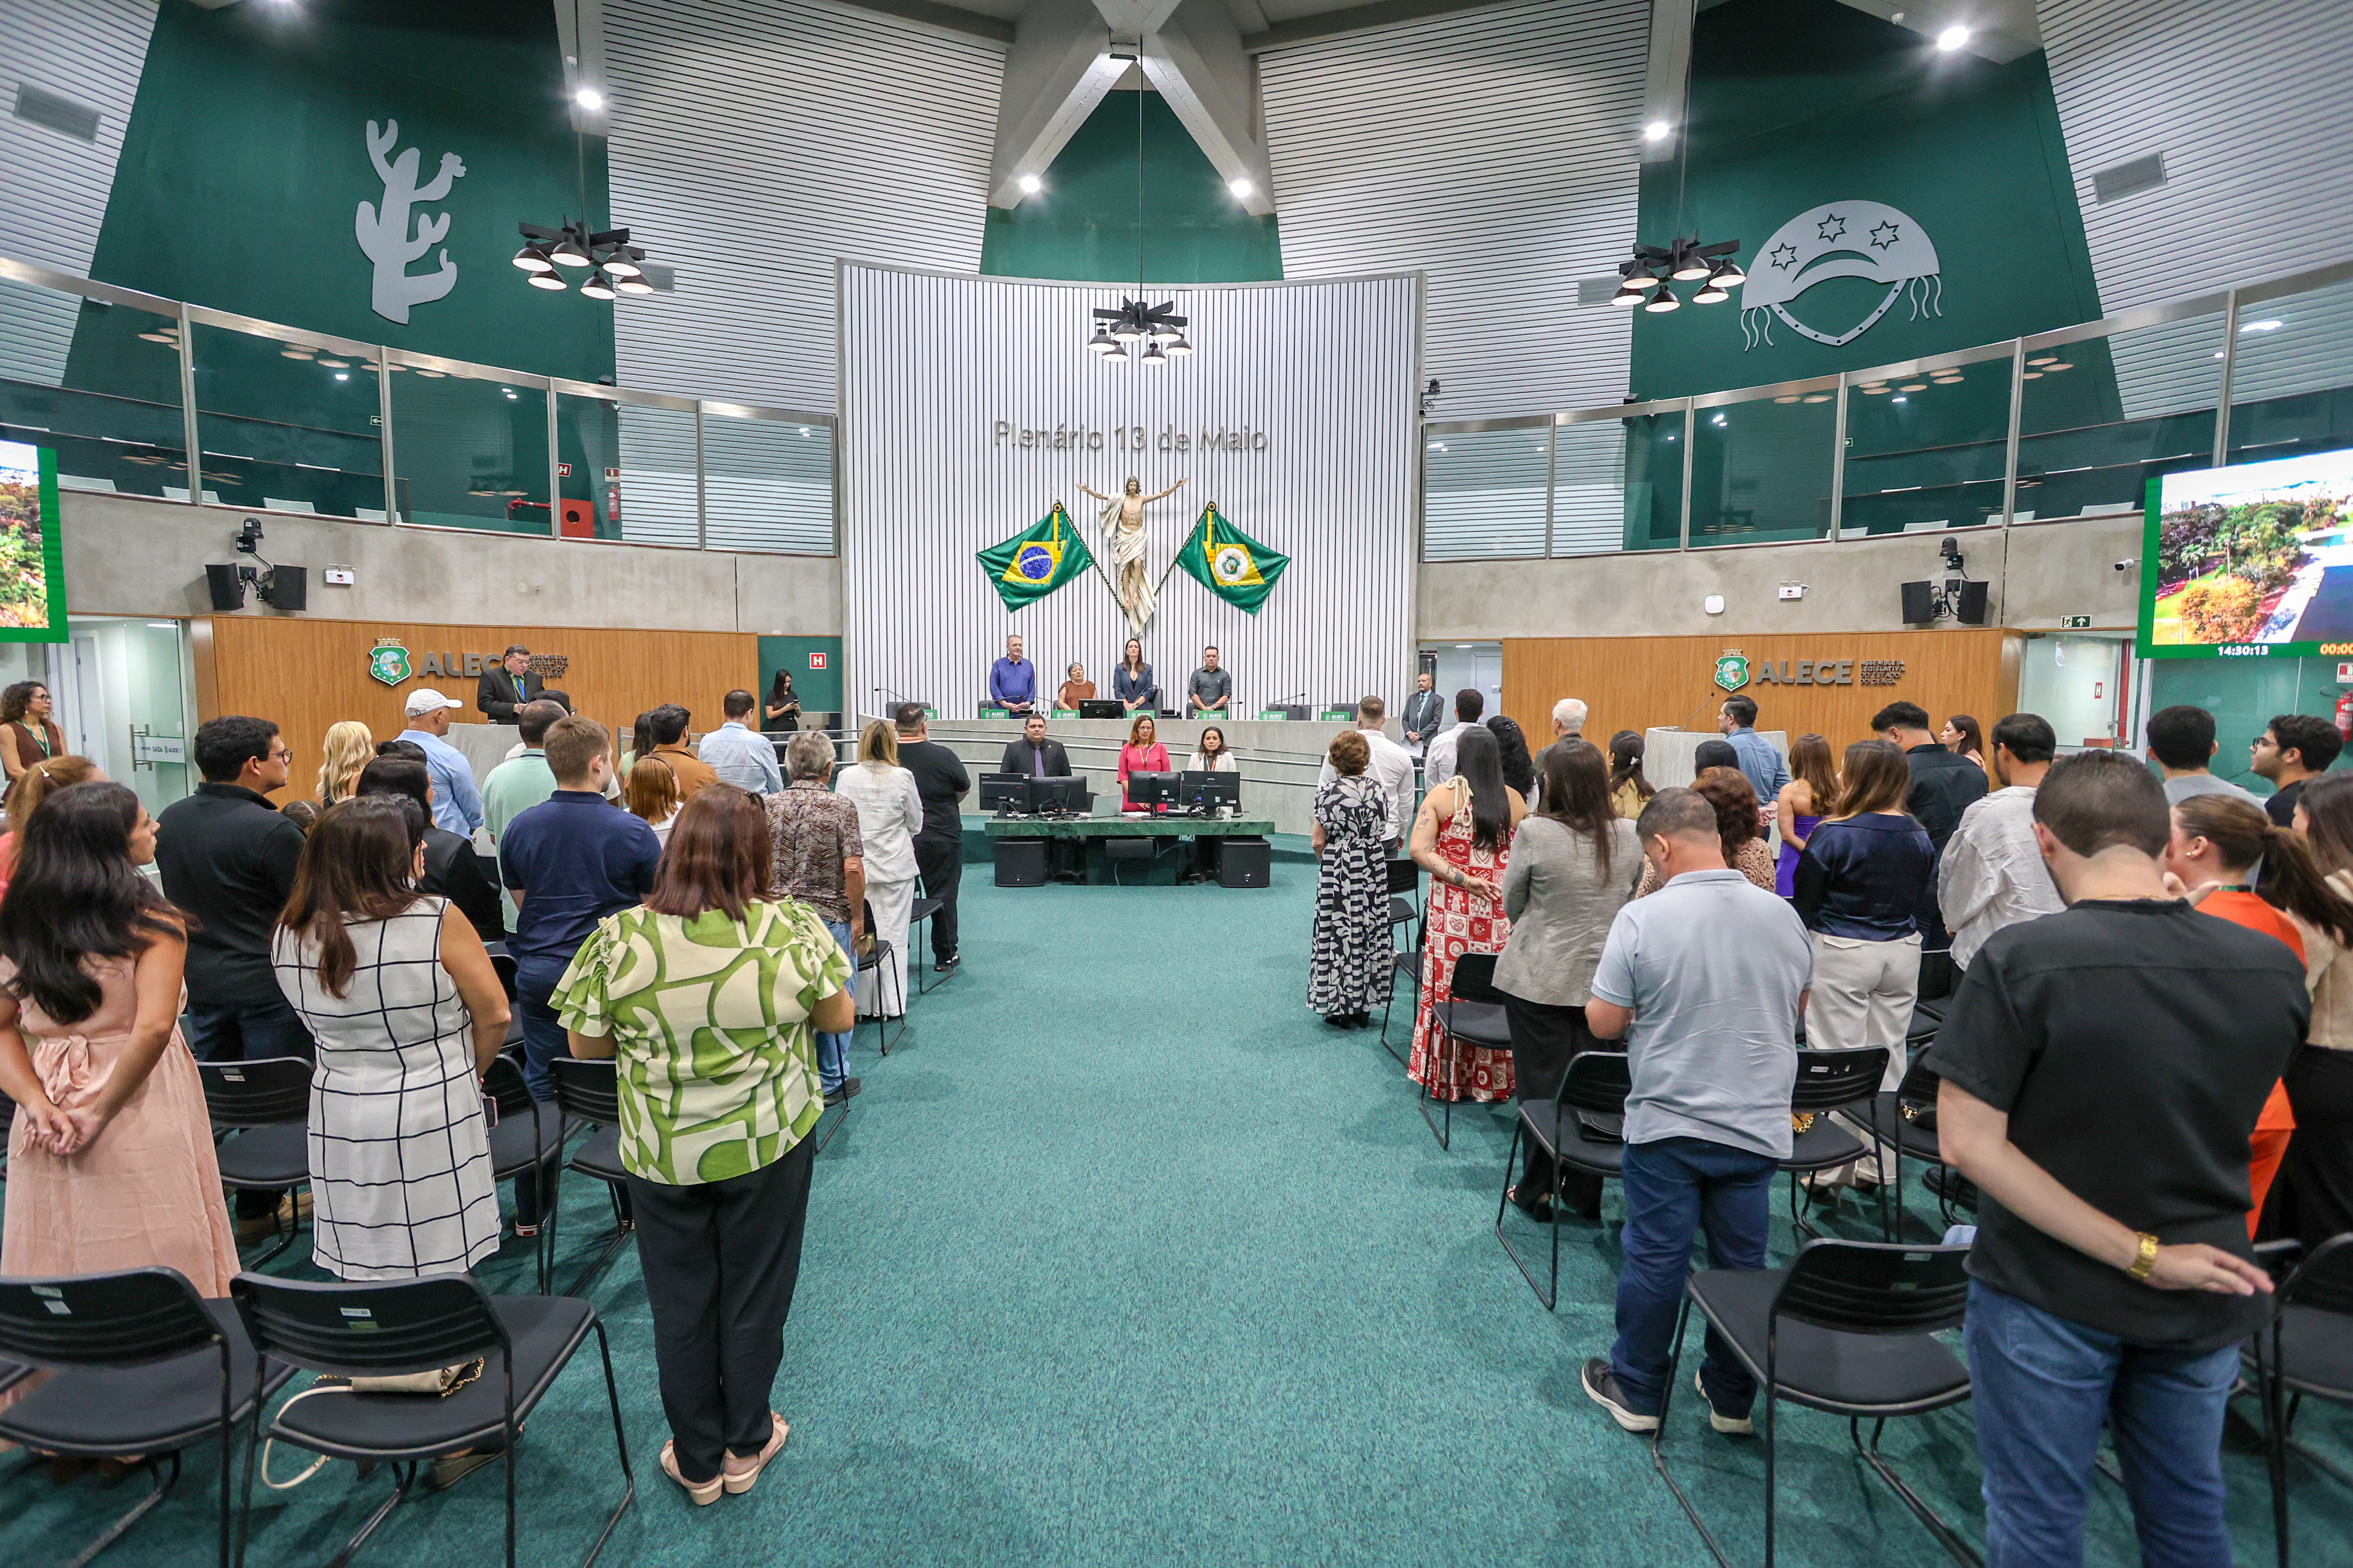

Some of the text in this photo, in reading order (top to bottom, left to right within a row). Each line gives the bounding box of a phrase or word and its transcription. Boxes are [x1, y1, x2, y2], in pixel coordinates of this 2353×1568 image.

[994, 421, 1268, 451] Plenário 13 de Maio
[559, 466, 568, 474] H
[2218, 645, 2269, 656] 14:30:13
[418, 652, 502, 677] ALEC
[813, 656, 822, 666] H
[1755, 660, 1853, 684] ALECE
[2095, 685, 2101, 696] H
